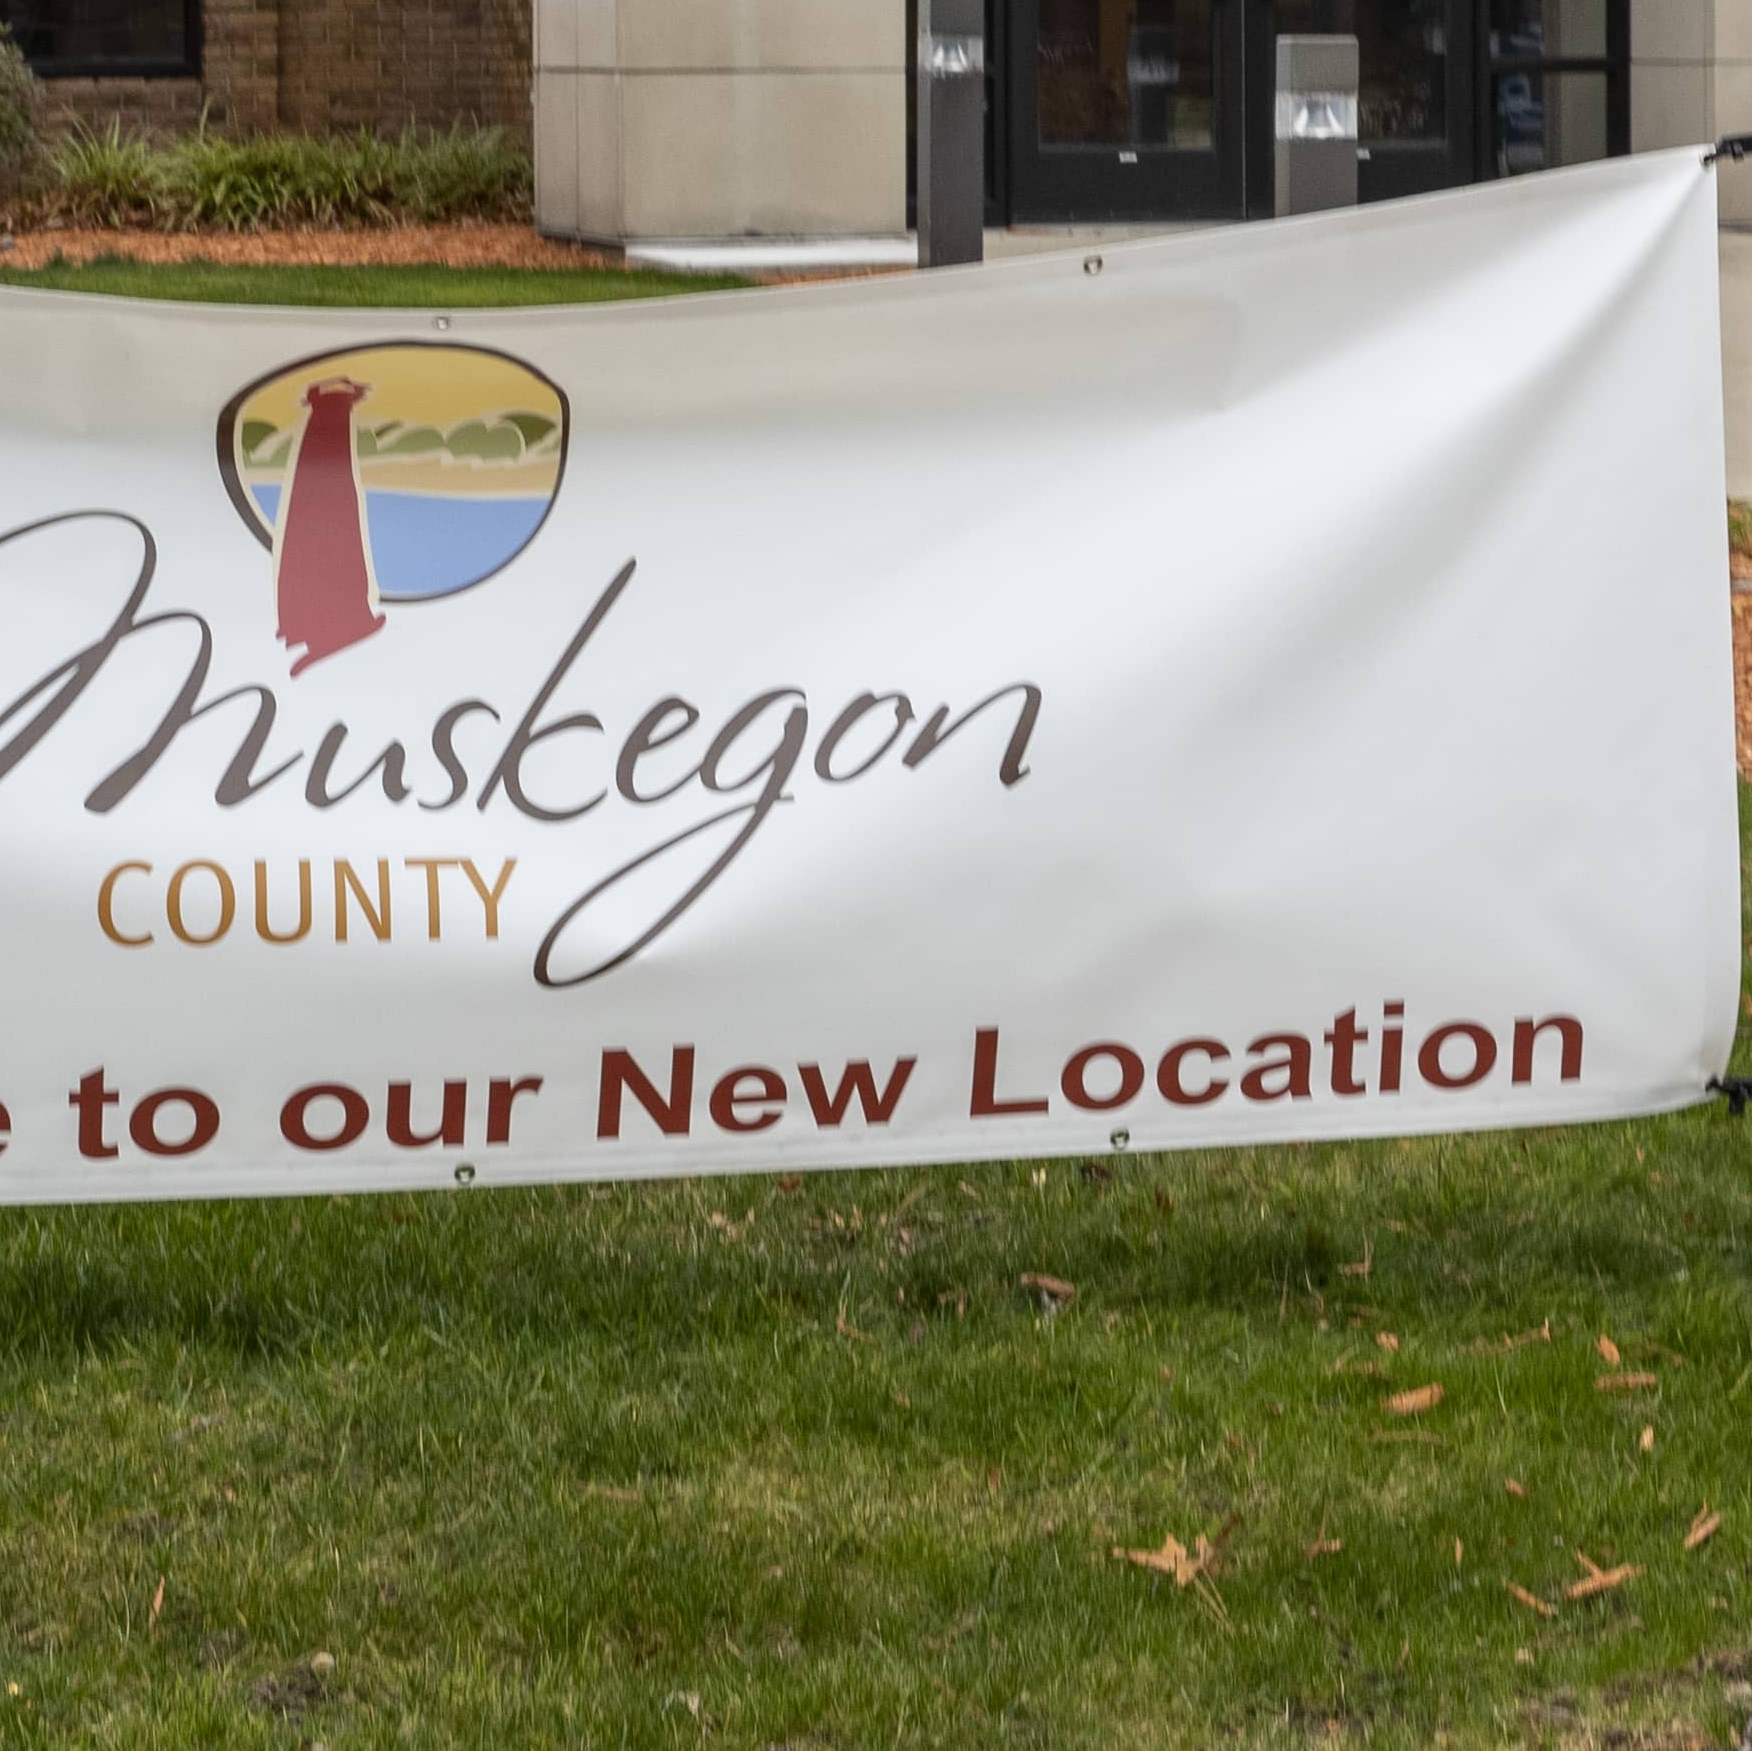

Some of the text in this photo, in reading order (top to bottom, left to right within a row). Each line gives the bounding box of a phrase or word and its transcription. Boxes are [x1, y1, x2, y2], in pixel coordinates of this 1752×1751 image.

[97, 859, 518, 948] COUNTY
[67, 1066, 222, 1160] to
[278, 1074, 545, 1152] our
[595, 1044, 919, 1140] New
[968, 1005, 1585, 1119] Location
